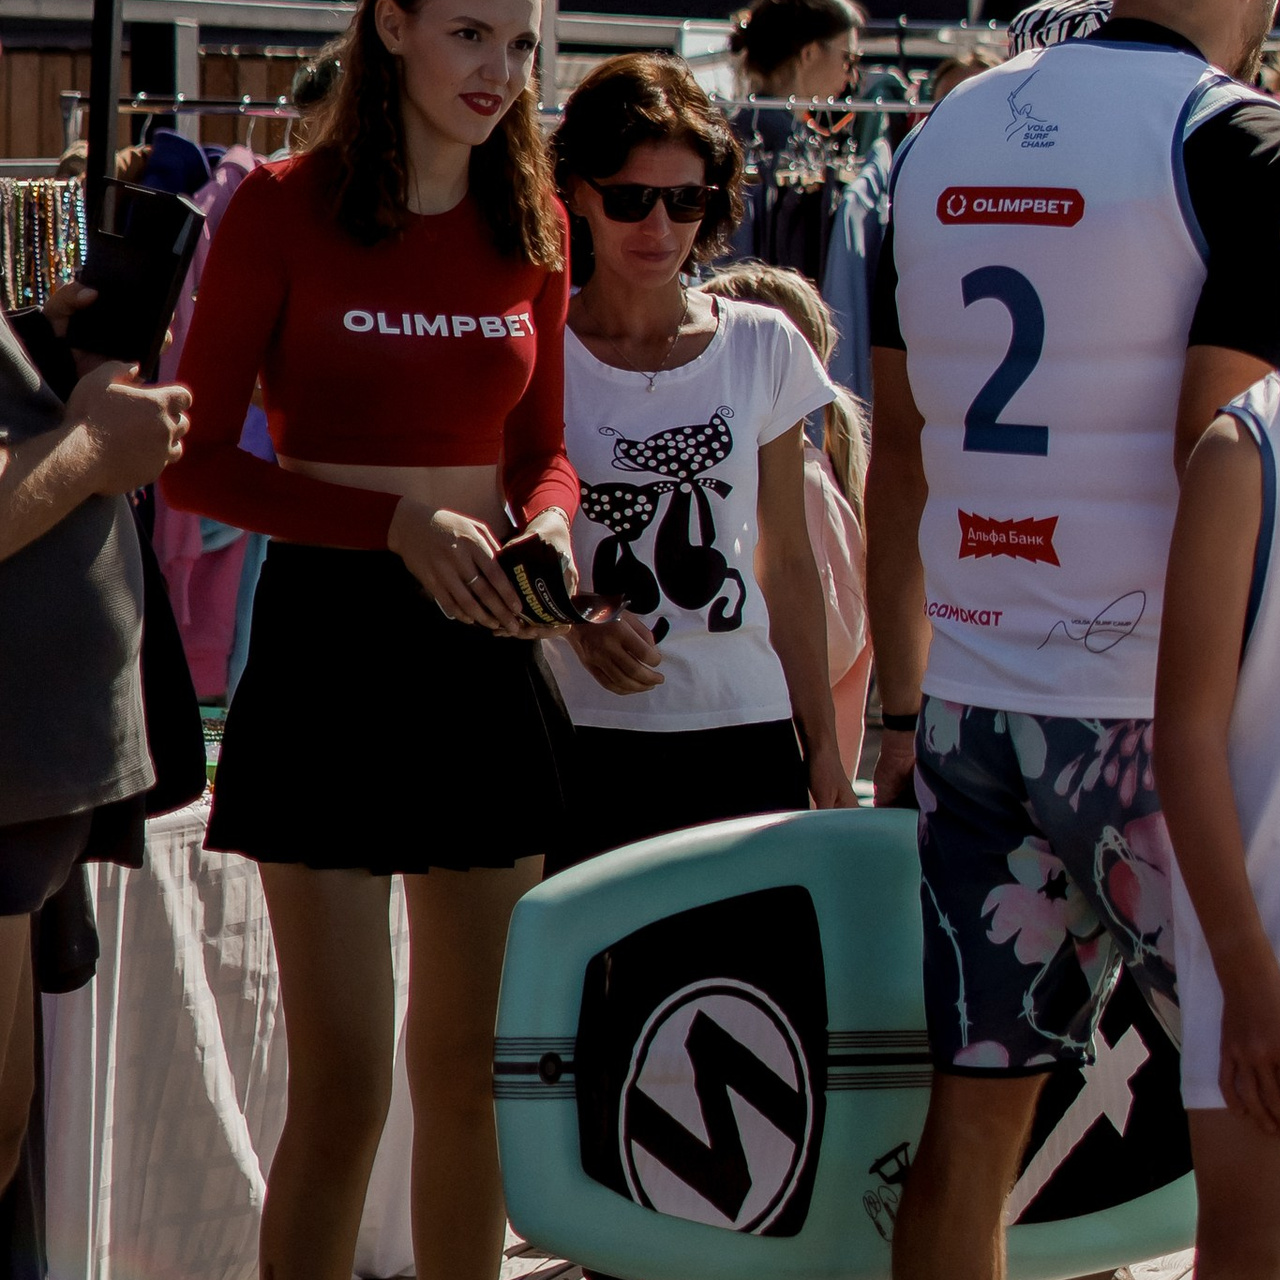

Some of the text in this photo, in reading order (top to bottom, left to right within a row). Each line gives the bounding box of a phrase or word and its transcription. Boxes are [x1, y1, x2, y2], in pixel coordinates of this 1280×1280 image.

[1023, 132, 1049, 140] SURF
[1027, 124, 1059, 133] VOLGA
[1020, 141, 1056, 149] CHAMP
[972, 197, 1074, 216] OLIMPBET
[343, 309, 535, 339] OLIMPBET
[960, 264, 1050, 457] 2
[967, 526, 1045, 547] Альфа Банк
[928, 602, 1003, 627] самокат
